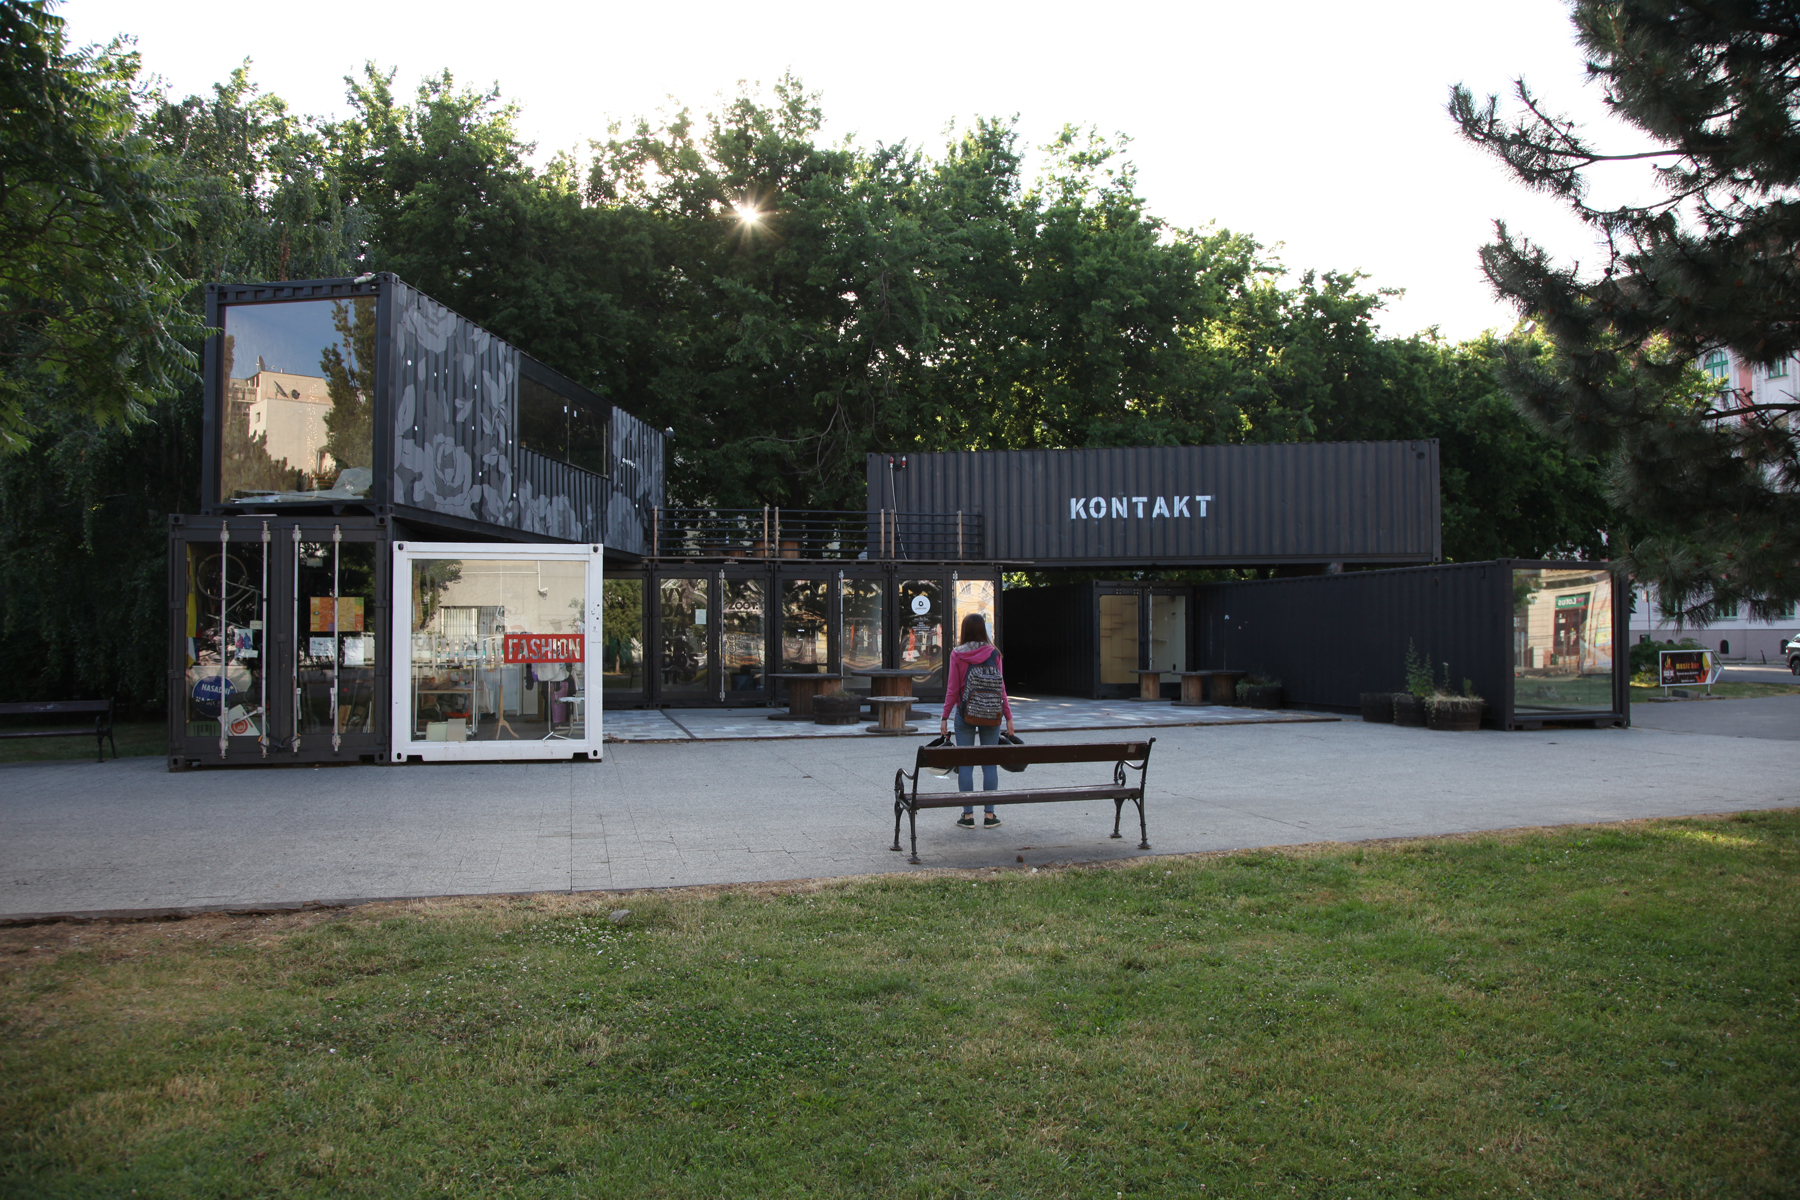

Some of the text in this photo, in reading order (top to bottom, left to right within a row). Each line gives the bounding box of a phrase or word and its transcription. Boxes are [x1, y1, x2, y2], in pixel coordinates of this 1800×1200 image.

[1070, 495, 1212, 520] KONTAKT
[508, 638, 580, 660] FASHION
[1676, 661, 1700, 670] music bar
